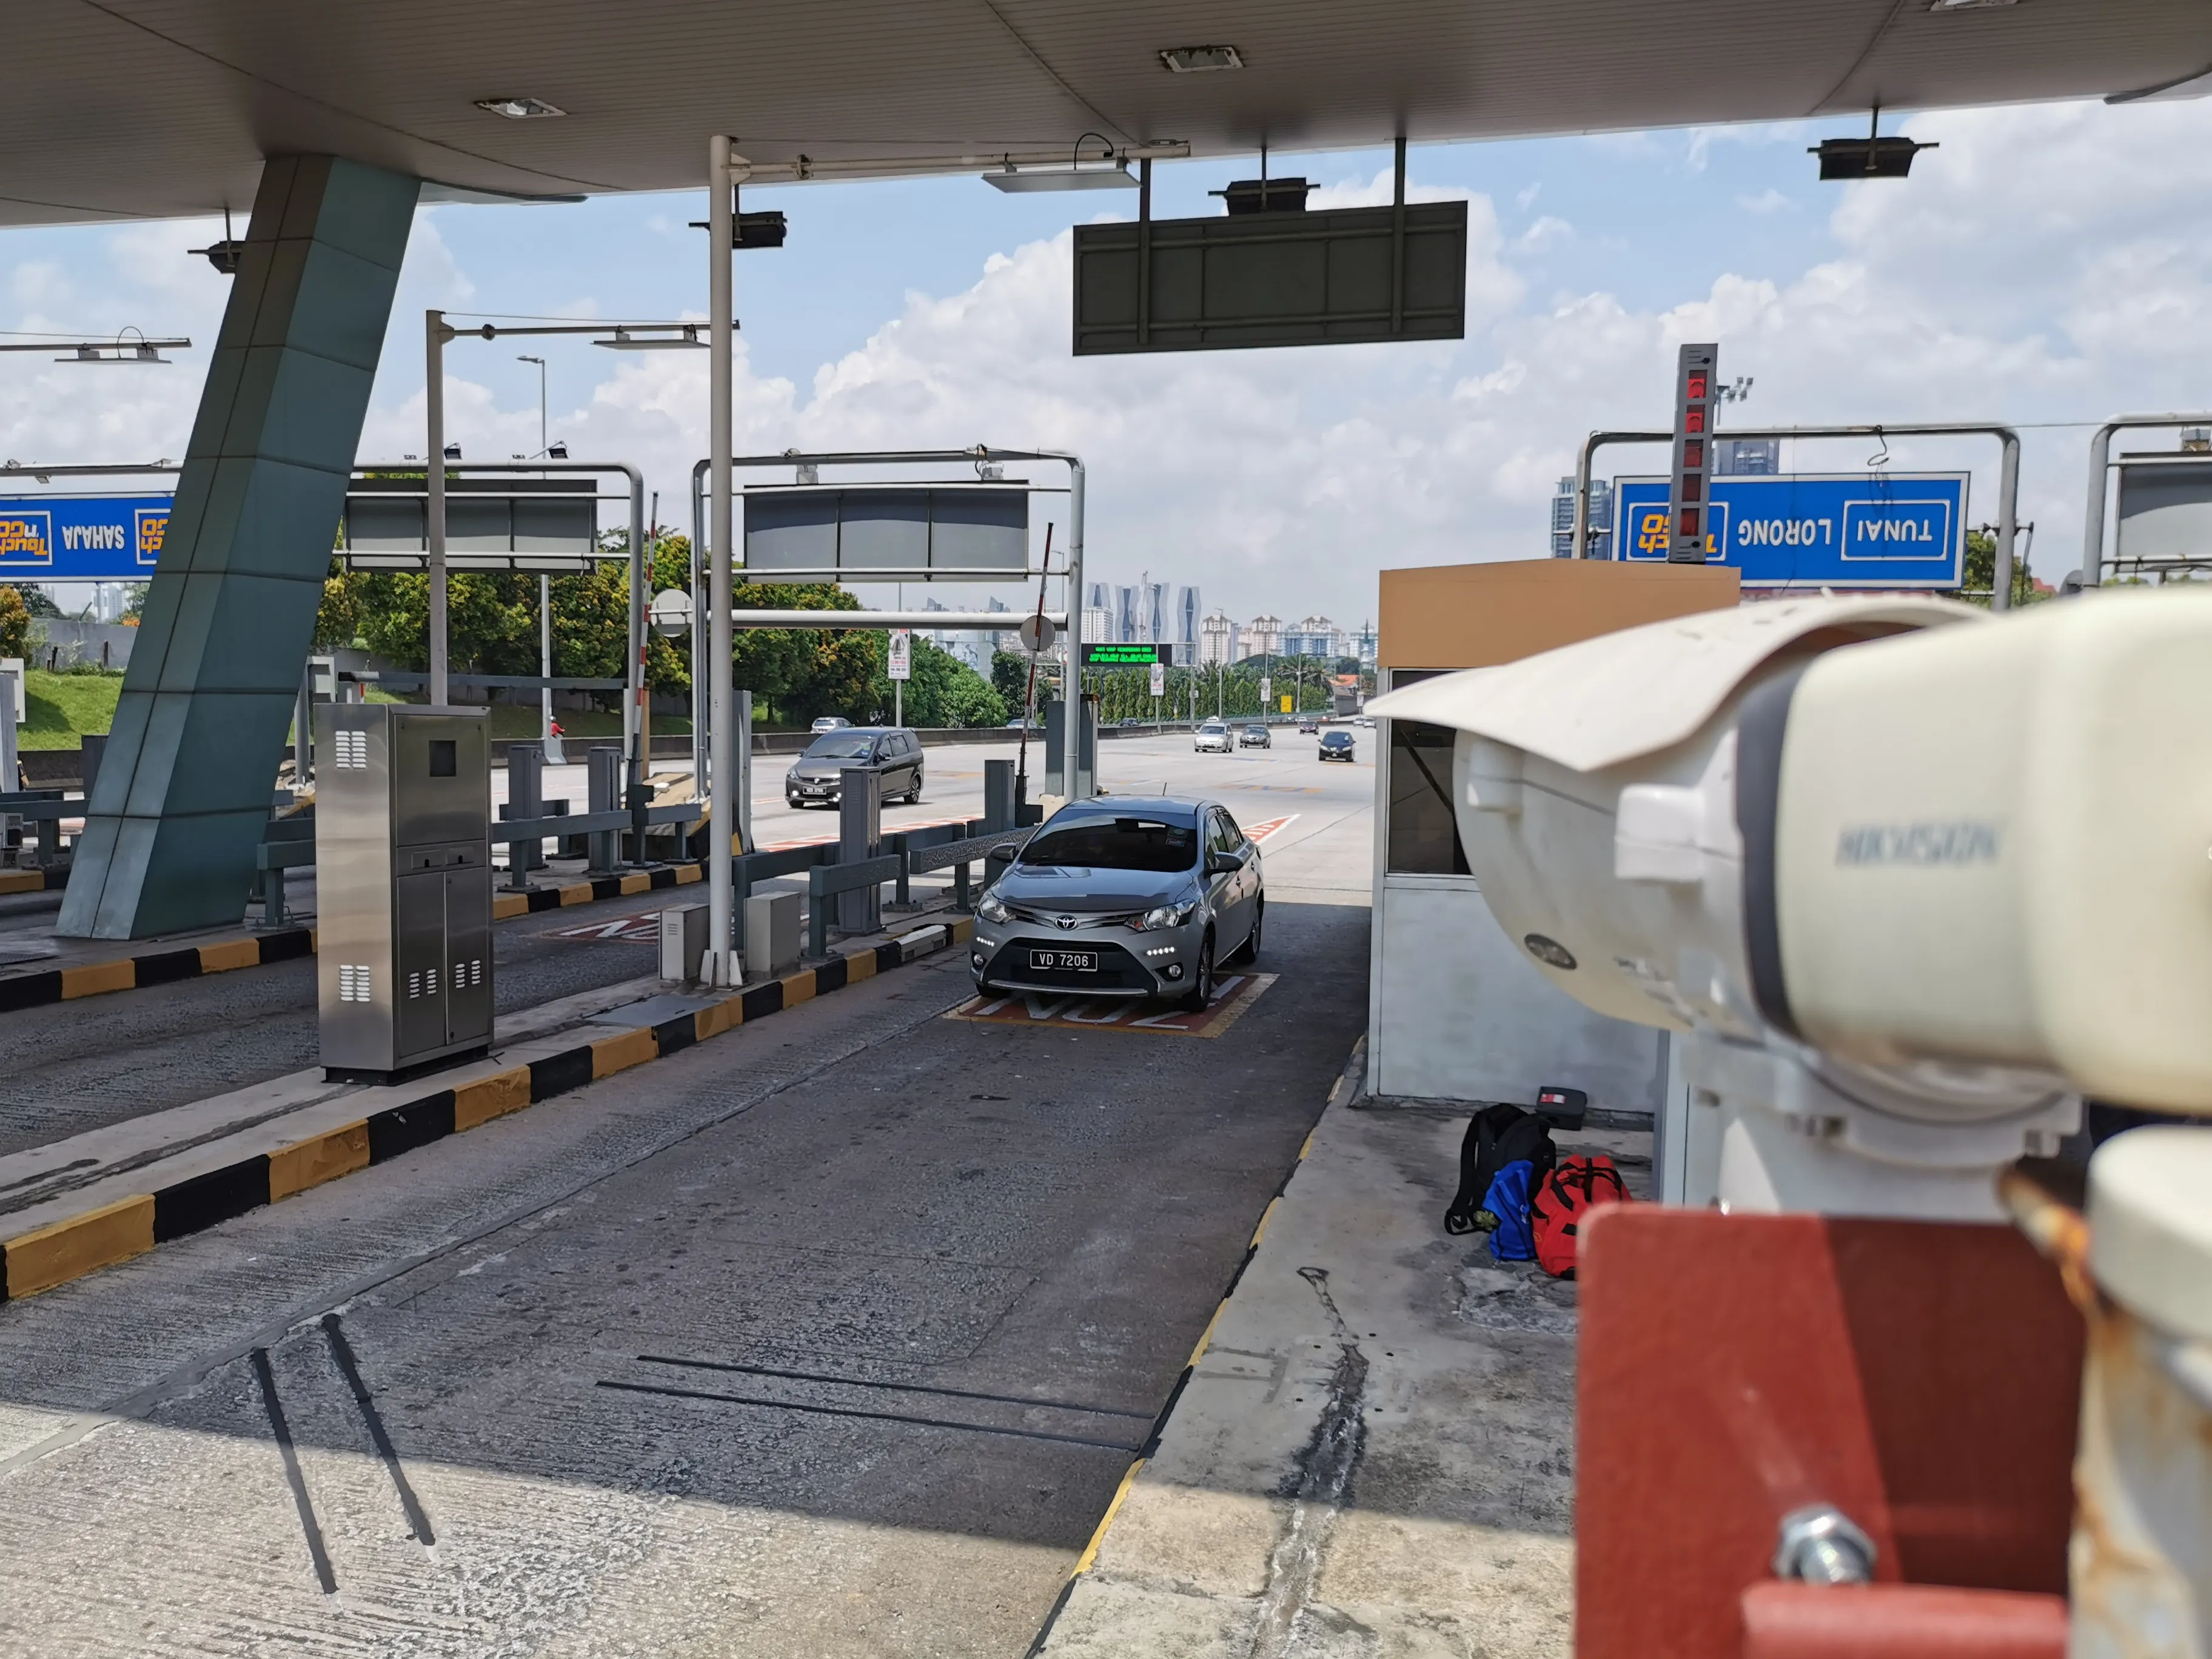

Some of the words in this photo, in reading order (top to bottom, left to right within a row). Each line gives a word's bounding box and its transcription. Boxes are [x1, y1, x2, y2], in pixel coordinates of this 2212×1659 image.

[61, 524, 126, 550] SAHAJA
[1738, 518, 1831, 546] LORONG
[1857, 518, 1933, 541] TUNAI
[1638, 534, 1717, 554] Tch
[1039, 953, 1054, 966] VD
[1059, 954, 1089, 967] 7206
